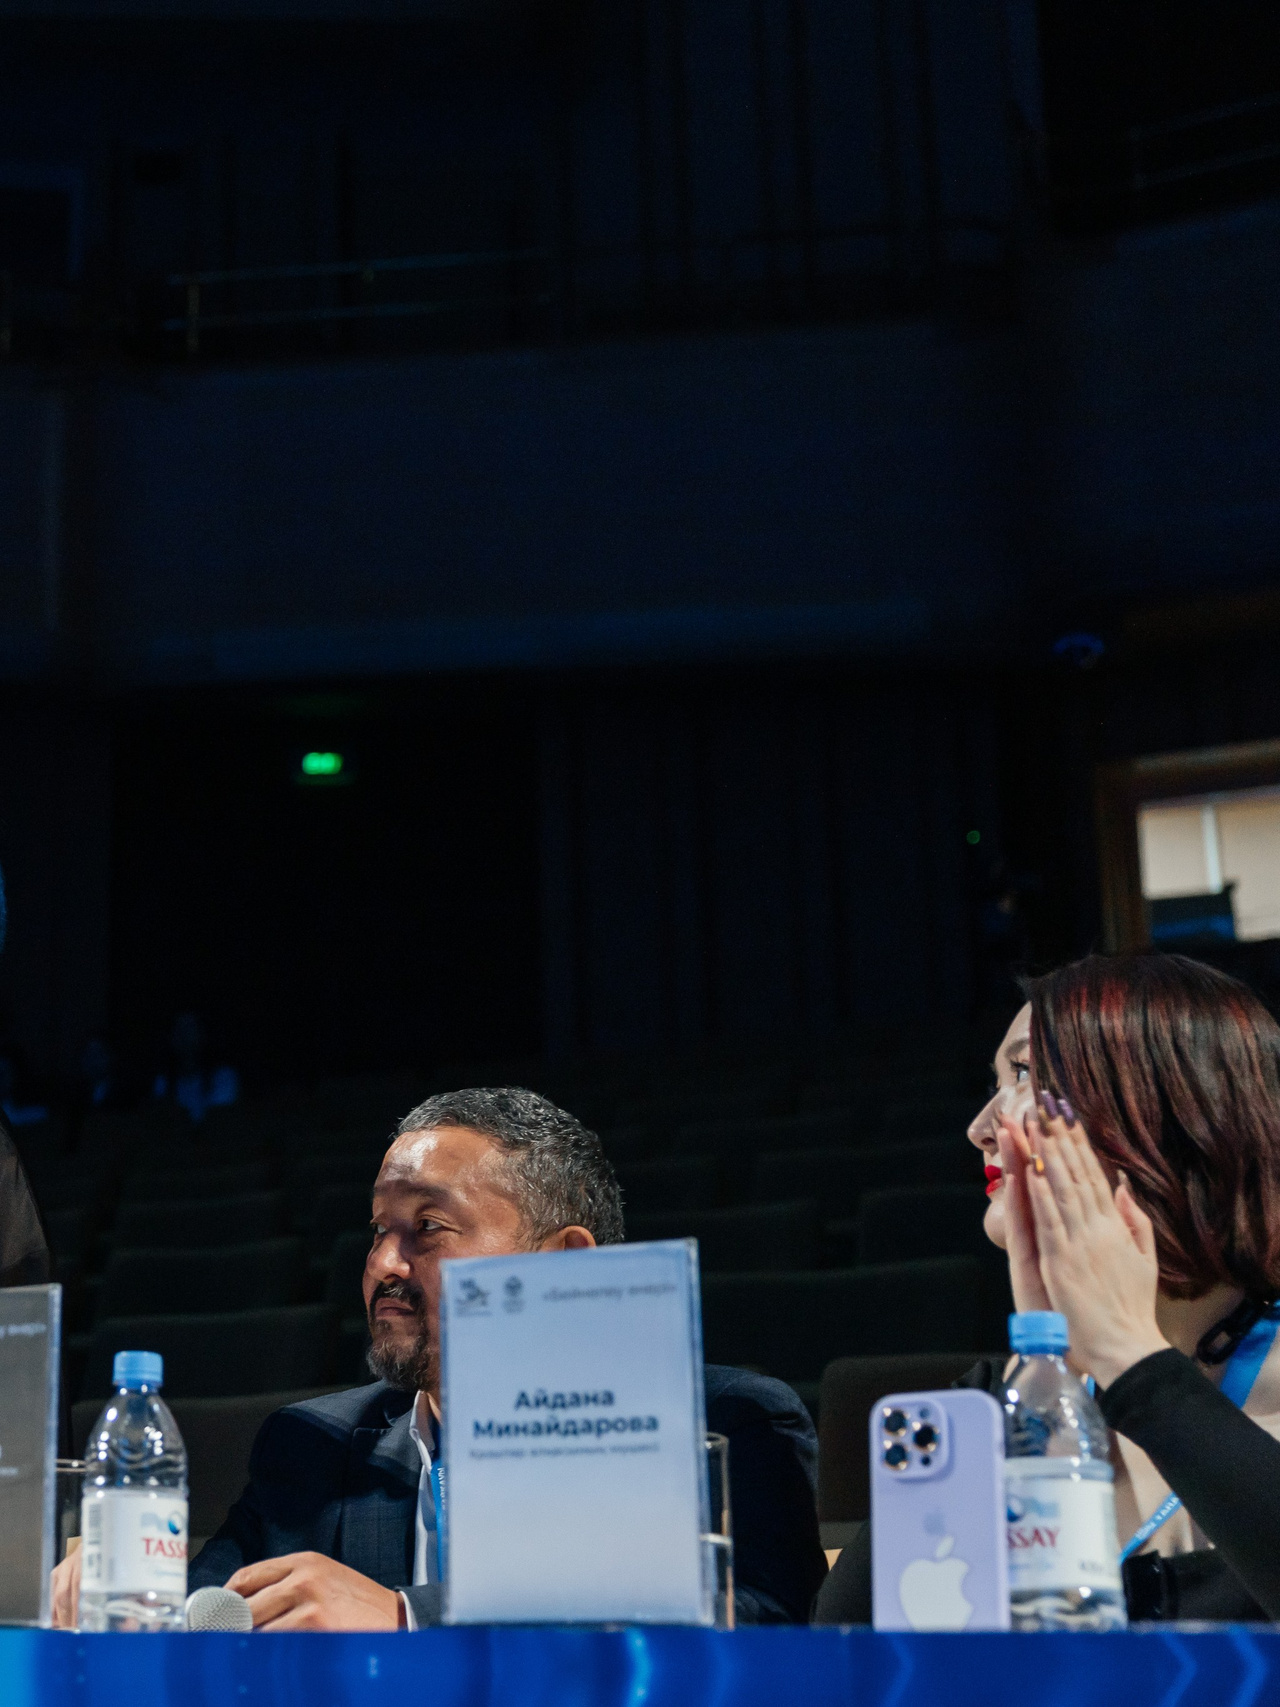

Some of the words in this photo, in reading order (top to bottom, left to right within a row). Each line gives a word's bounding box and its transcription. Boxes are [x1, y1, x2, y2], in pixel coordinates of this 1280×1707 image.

[514, 1388, 615, 1411] Айдана
[473, 1415, 659, 1438] Минайдарова
[142, 1538, 188, 1559] TASS
[1007, 1527, 1060, 1549] SSAY
